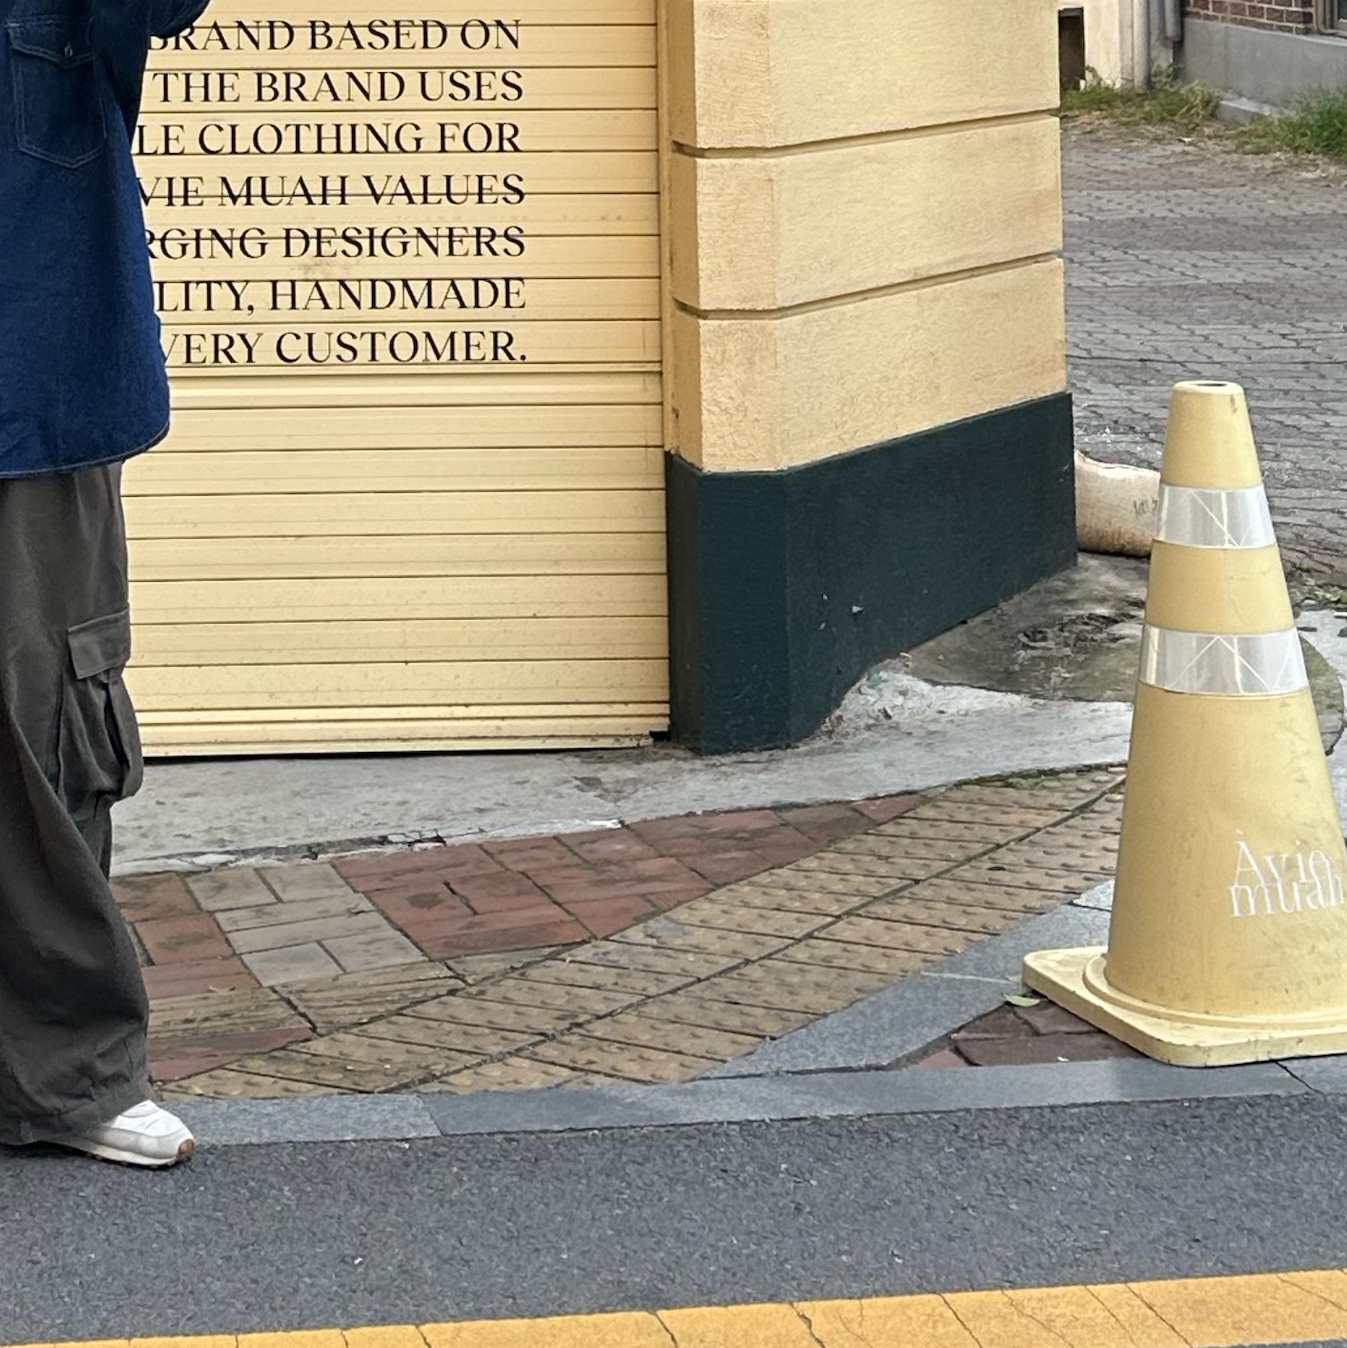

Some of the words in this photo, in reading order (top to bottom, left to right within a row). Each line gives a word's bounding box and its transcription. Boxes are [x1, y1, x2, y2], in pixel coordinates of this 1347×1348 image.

[307, 19, 448, 50] BASED
[459, 18, 521, 50] ON
[152, 72, 241, 103] THE
[253, 71, 406, 102] BRAND
[418, 70, 524, 102] USES
[198, 122, 424, 155] CLOTHING
[437, 122, 523, 154] FOR
[137, 176, 204, 207] VIE
[217, 175, 349, 207] MUAH
[361, 174, 525, 206] VALUES
[282, 226, 526, 259] DESIGNERS
[269, 278, 527, 311] HANDMADE
[275, 330, 528, 364] CUSTOMER.
[1227, 860, 1344, 917] muah
